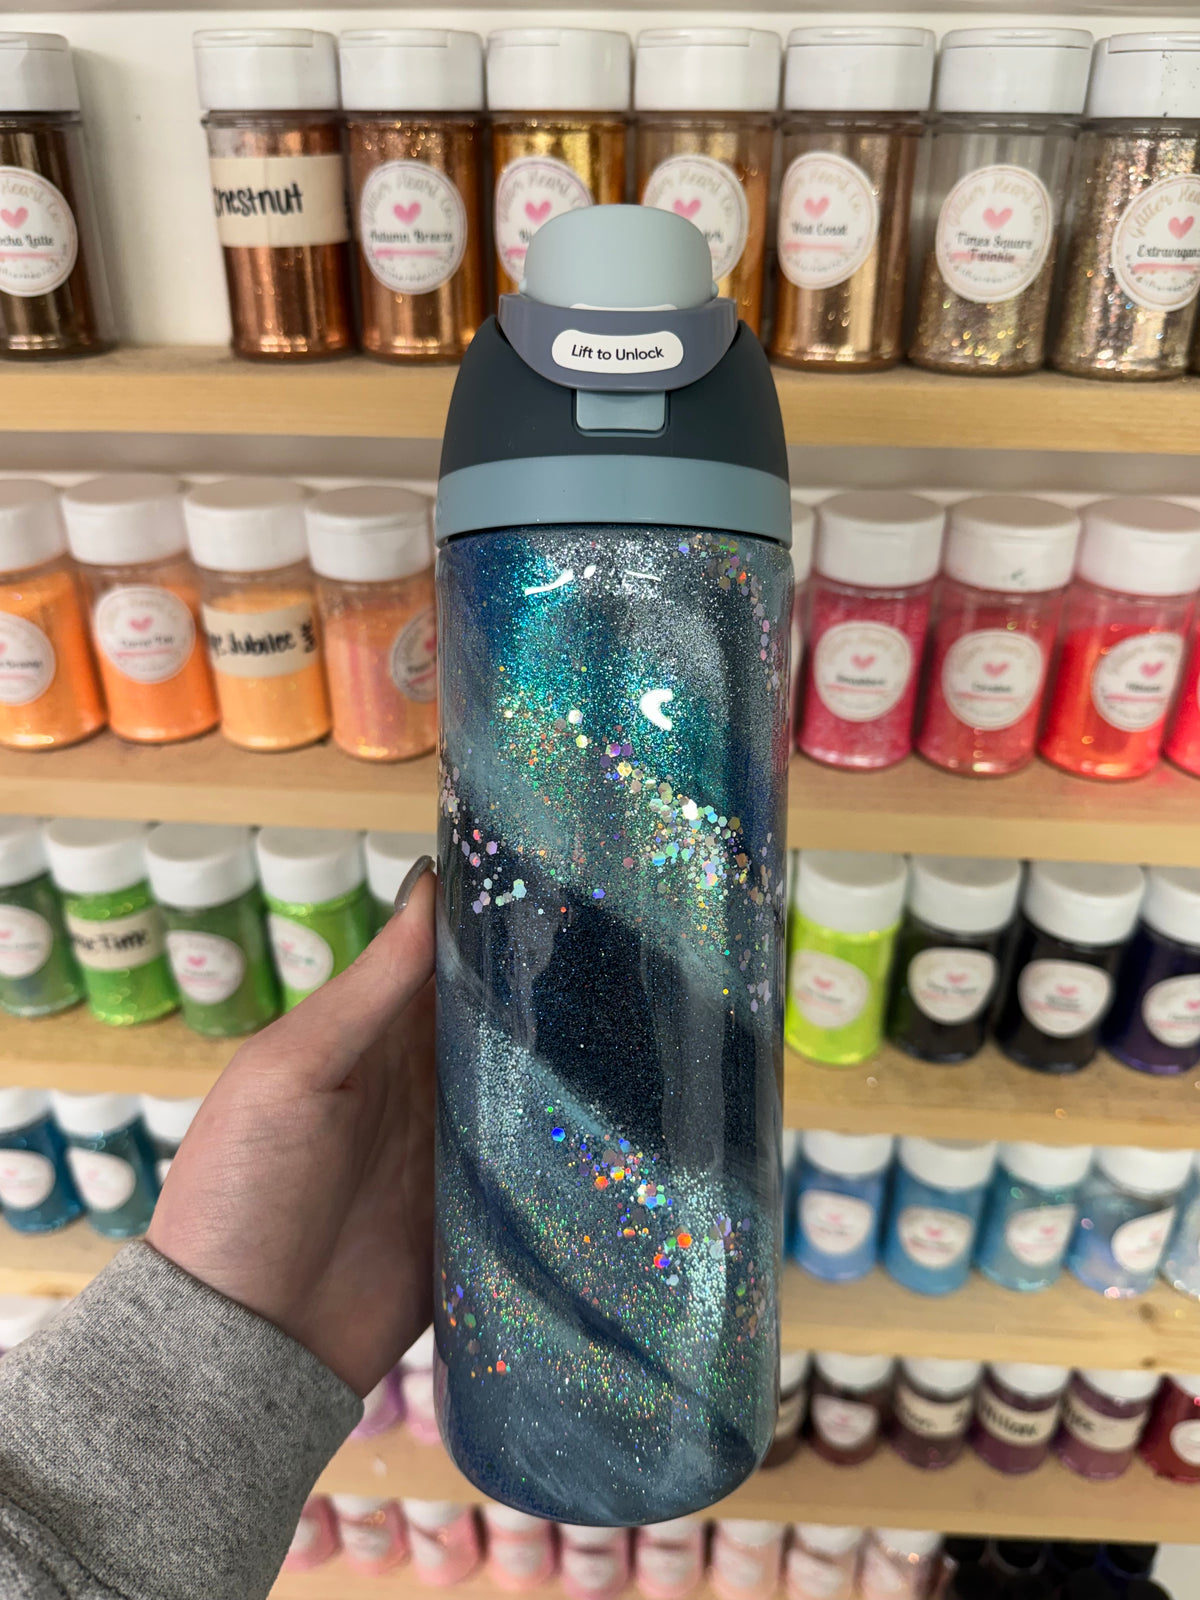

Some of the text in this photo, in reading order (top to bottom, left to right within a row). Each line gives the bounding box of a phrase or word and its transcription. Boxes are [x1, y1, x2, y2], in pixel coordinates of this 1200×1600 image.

[0, 234, 23, 247] cha
[571, 344, 664, 361] Lift to Unlock
